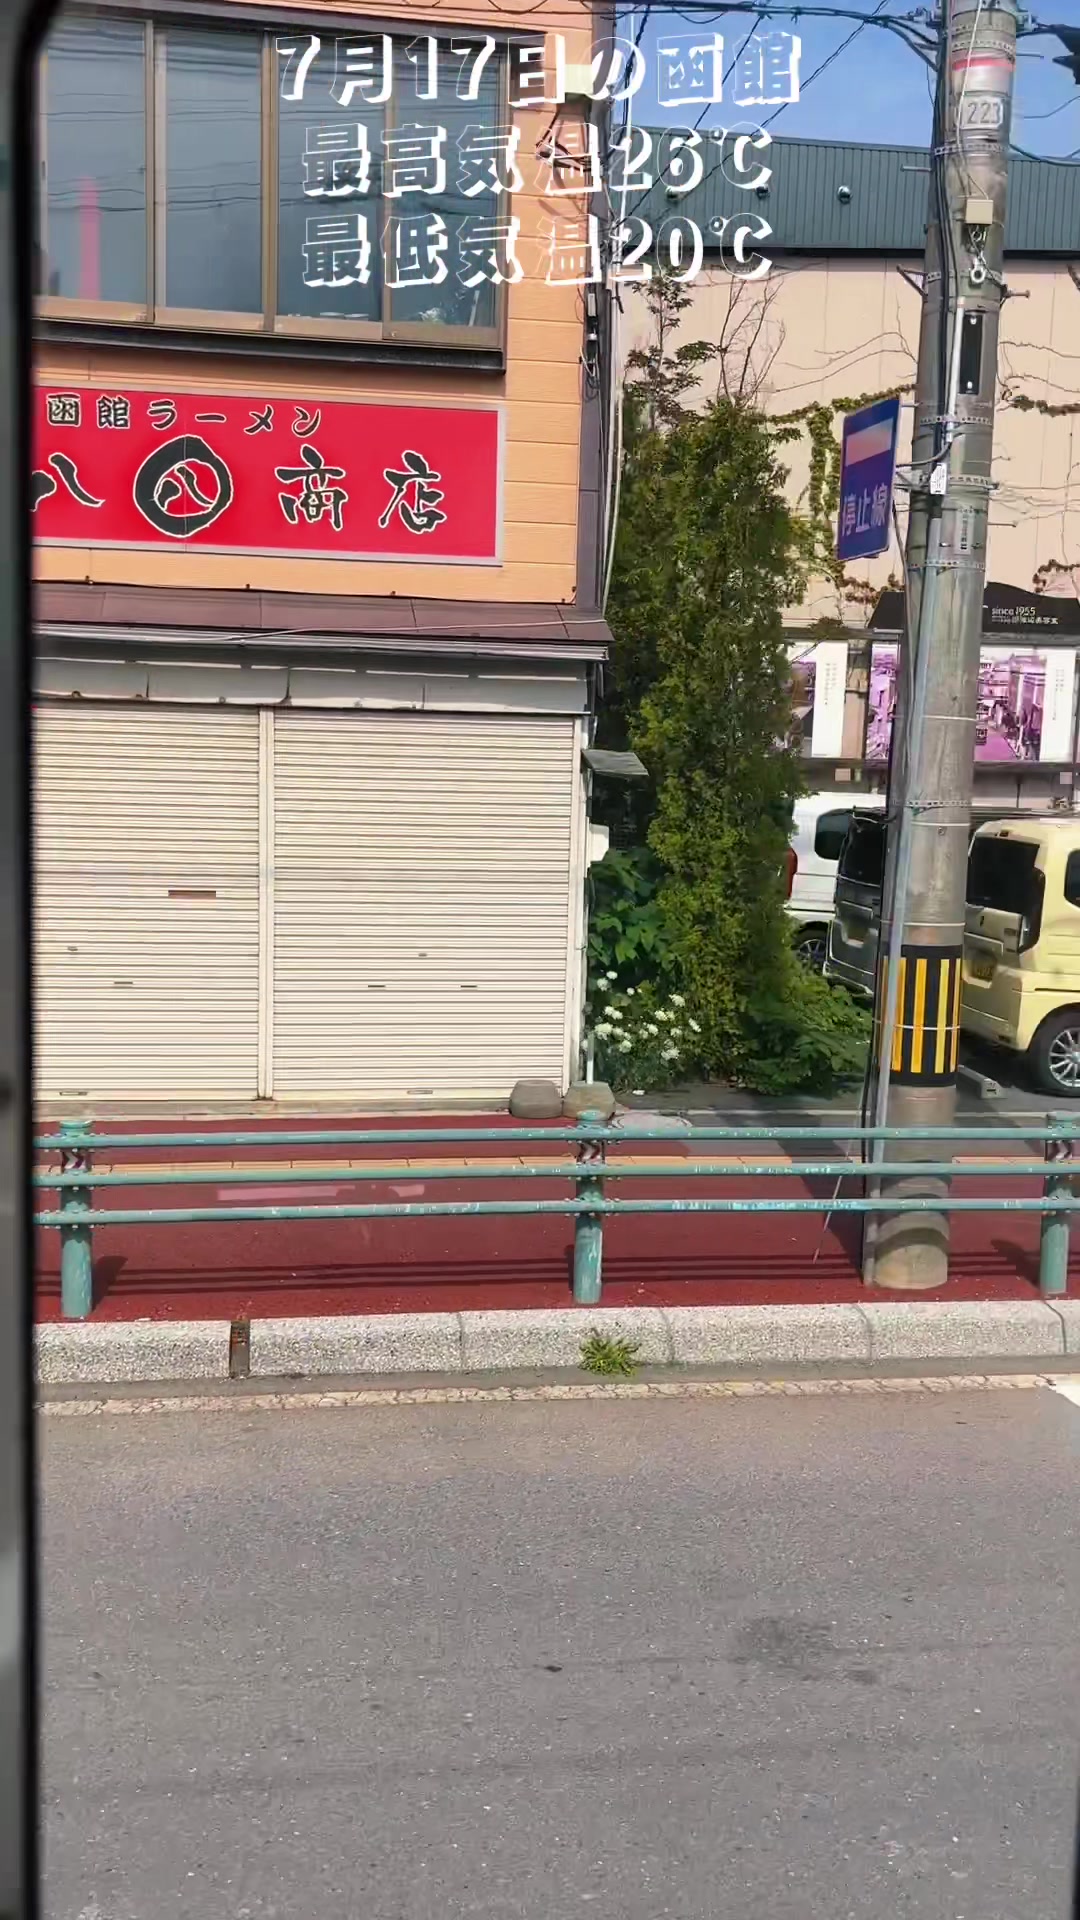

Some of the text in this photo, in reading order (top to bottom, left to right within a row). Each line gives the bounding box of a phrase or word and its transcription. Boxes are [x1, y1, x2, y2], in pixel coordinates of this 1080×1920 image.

[967, 101, 1001, 124] 223
[47, 392, 322, 438] 函館ラーメン
[841, 481, 888, 537] 停止線
